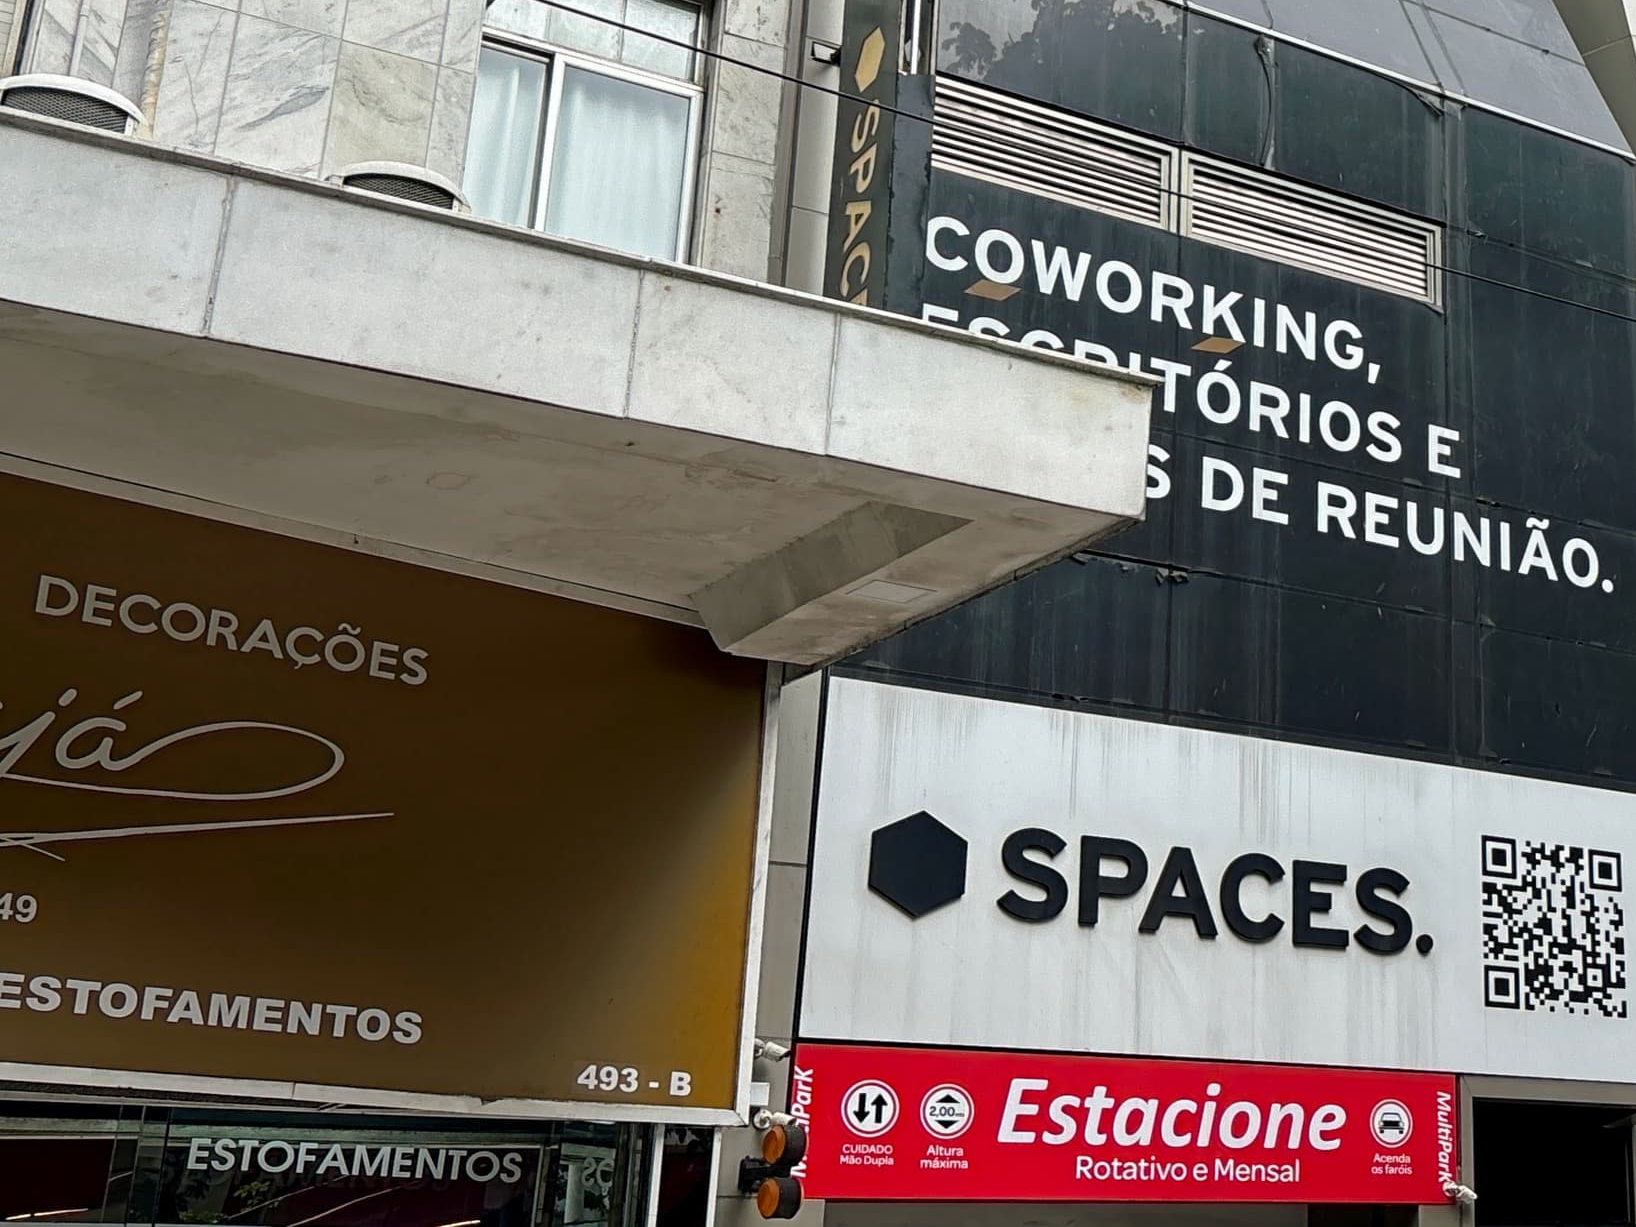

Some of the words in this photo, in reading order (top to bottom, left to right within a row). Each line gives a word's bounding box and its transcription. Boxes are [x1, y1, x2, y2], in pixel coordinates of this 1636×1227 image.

[840, 100, 881, 306] SPAC
[926, 216, 1381, 384] COWORKING,
[1428, 423, 1461, 478] E
[1201, 455, 1289, 525] DE
[1317, 481, 1614, 593] REUNIÃO.
[35, 575, 429, 685] DECORAÇÕES
[996, 827, 1434, 956] SPACES.
[0, 973, 423, 1045] ESTOFAMENTOS
[577, 1064, 639, 1093] 493
[669, 1071, 692, 1096] B
[997, 1078, 1347, 1151] Estacione
[186, 1137, 523, 1184] ESTOFAMENTOS
[840, 1155, 862, 1165] Mão
[864, 1155, 894, 1167] Dupla
[842, 1144, 894, 1154] CUIDADO
[920, 1157, 968, 1169] máxima
[926, 1145, 964, 1157] Altura
[1075, 1155, 1188, 1181] Rotativo
[1192, 1163, 1209, 1182] e
[1214, 1158, 1300, 1183] Mensal
[1371, 1166, 1383, 1174] os
[1385, 1164, 1413, 1175] faróis
[1373, 1153, 1411, 1164] Acenda
